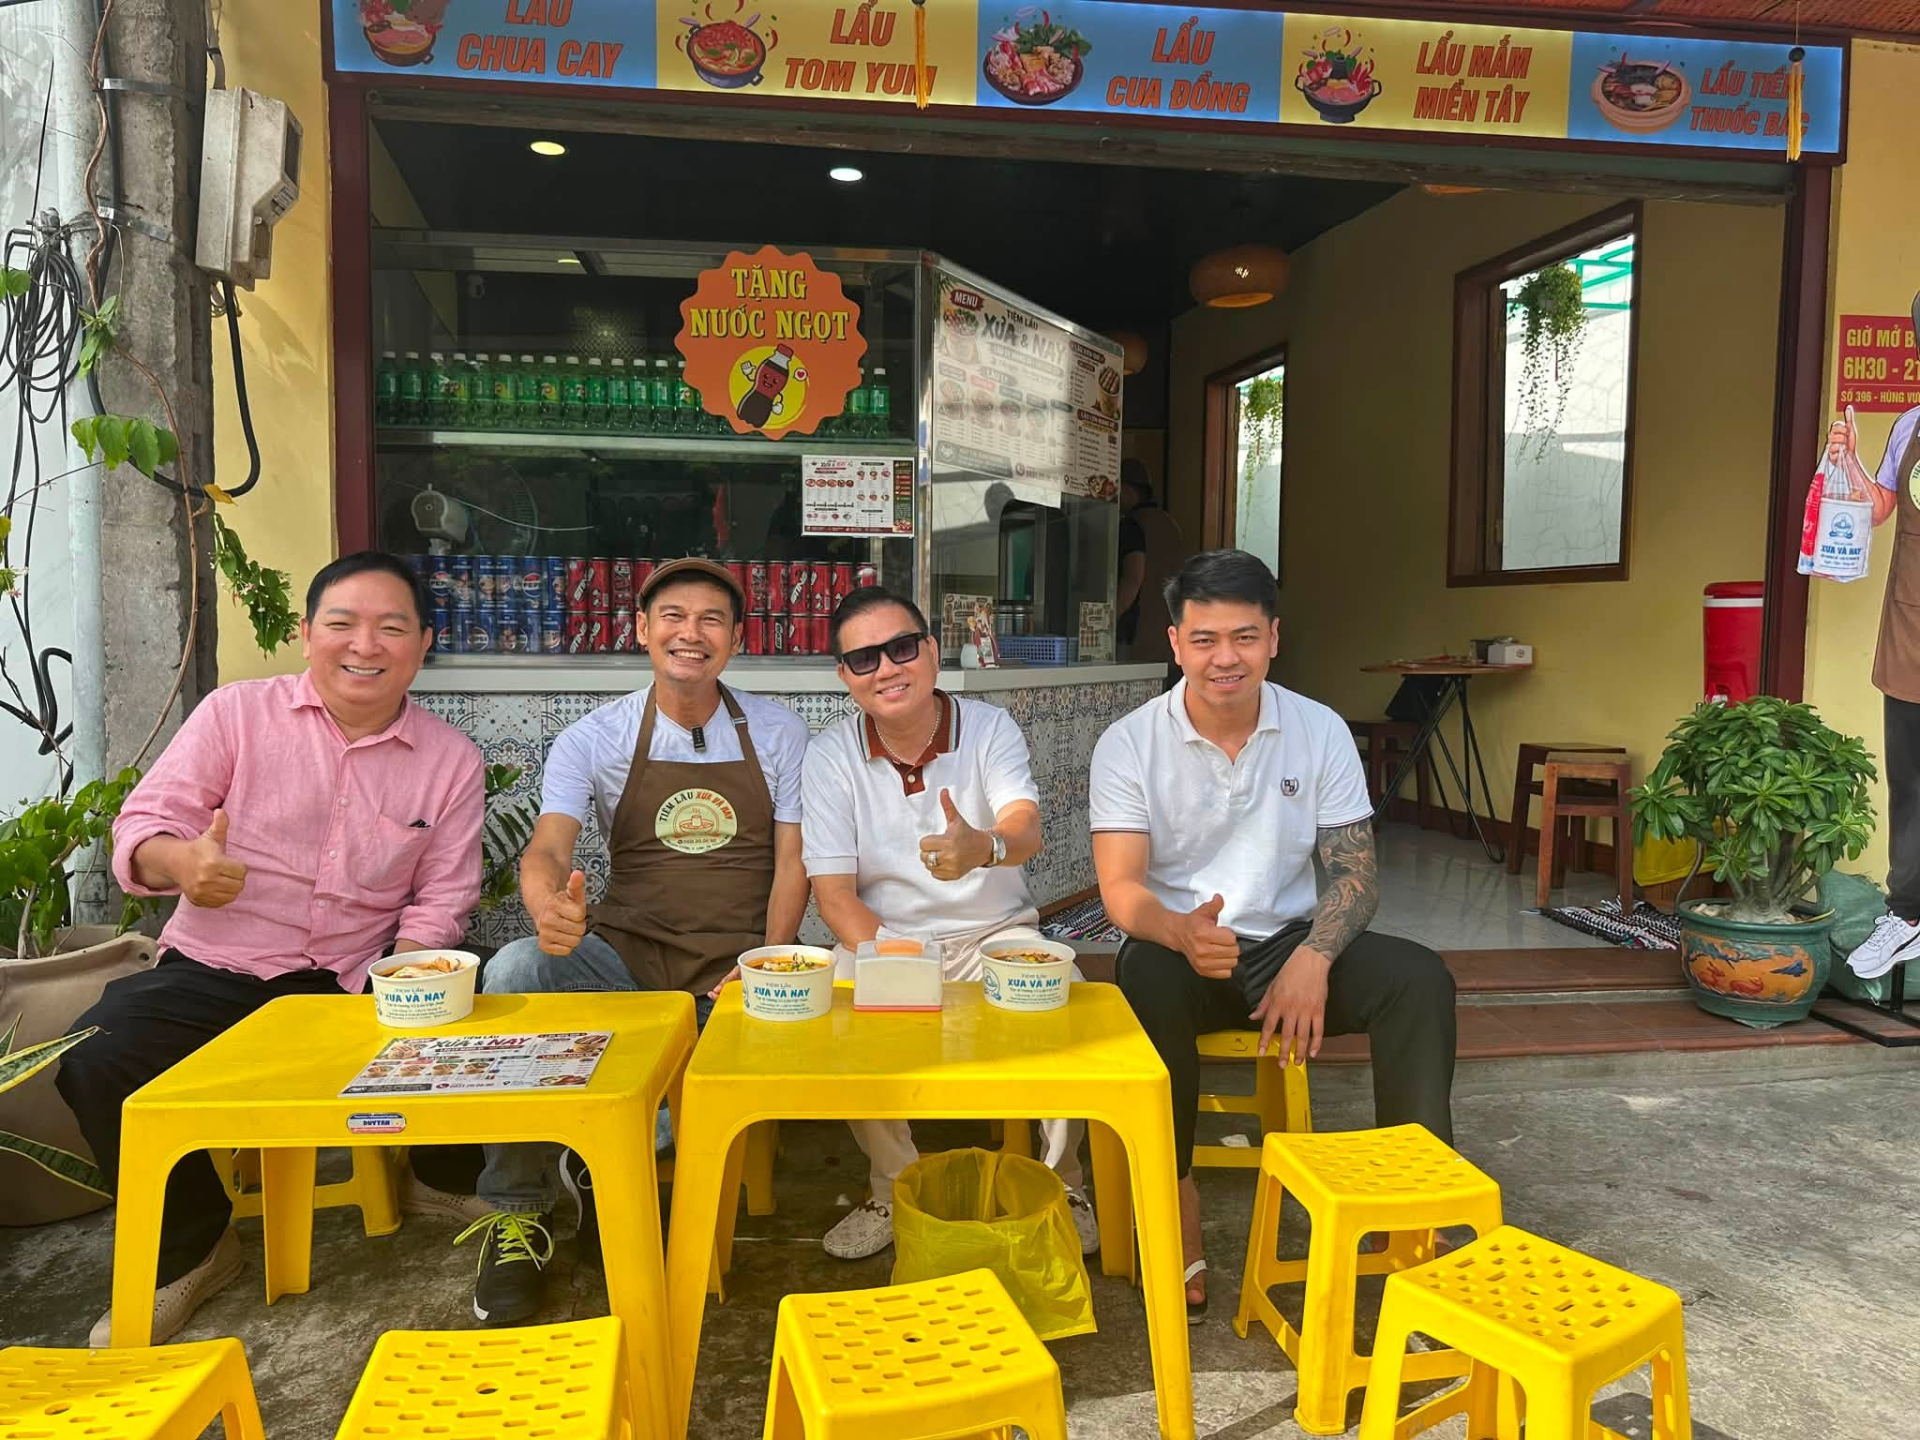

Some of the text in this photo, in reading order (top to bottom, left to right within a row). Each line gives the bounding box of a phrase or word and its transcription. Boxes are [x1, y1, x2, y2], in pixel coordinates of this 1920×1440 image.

[830, 0, 897, 47] LẨU
[1152, 15, 1216, 66] LẨU
[456, 33, 624, 78] CHUA CAY
[1416, 30, 1533, 79] LẨU MẮM
[784, 57, 857, 92] TOM
[1106, 70, 1251, 114] CUA ĐỒNG
[1700, 60, 1748, 97] LẨU
[1413, 78, 1531, 124] MIỀN TÂY
[1689, 101, 1761, 136] THUỐC
[731, 264, 807, 301] TẶNG
[954, 291, 979, 308] MENU
[689, 304, 850, 343] NƯỚC NGỌT
[1846, 324, 1873, 347] GIỜ
[1876, 324, 1901, 348] MỞ
[1843, 356, 1888, 380] 6H30
[1840, 387, 1853, 402] SỐ
[1880, 389, 1905, 403] HÙNG
[424, 990, 446, 1002] NAY
[790, 987, 810, 998] NAY
[1045, 976, 1062, 987] NAY
